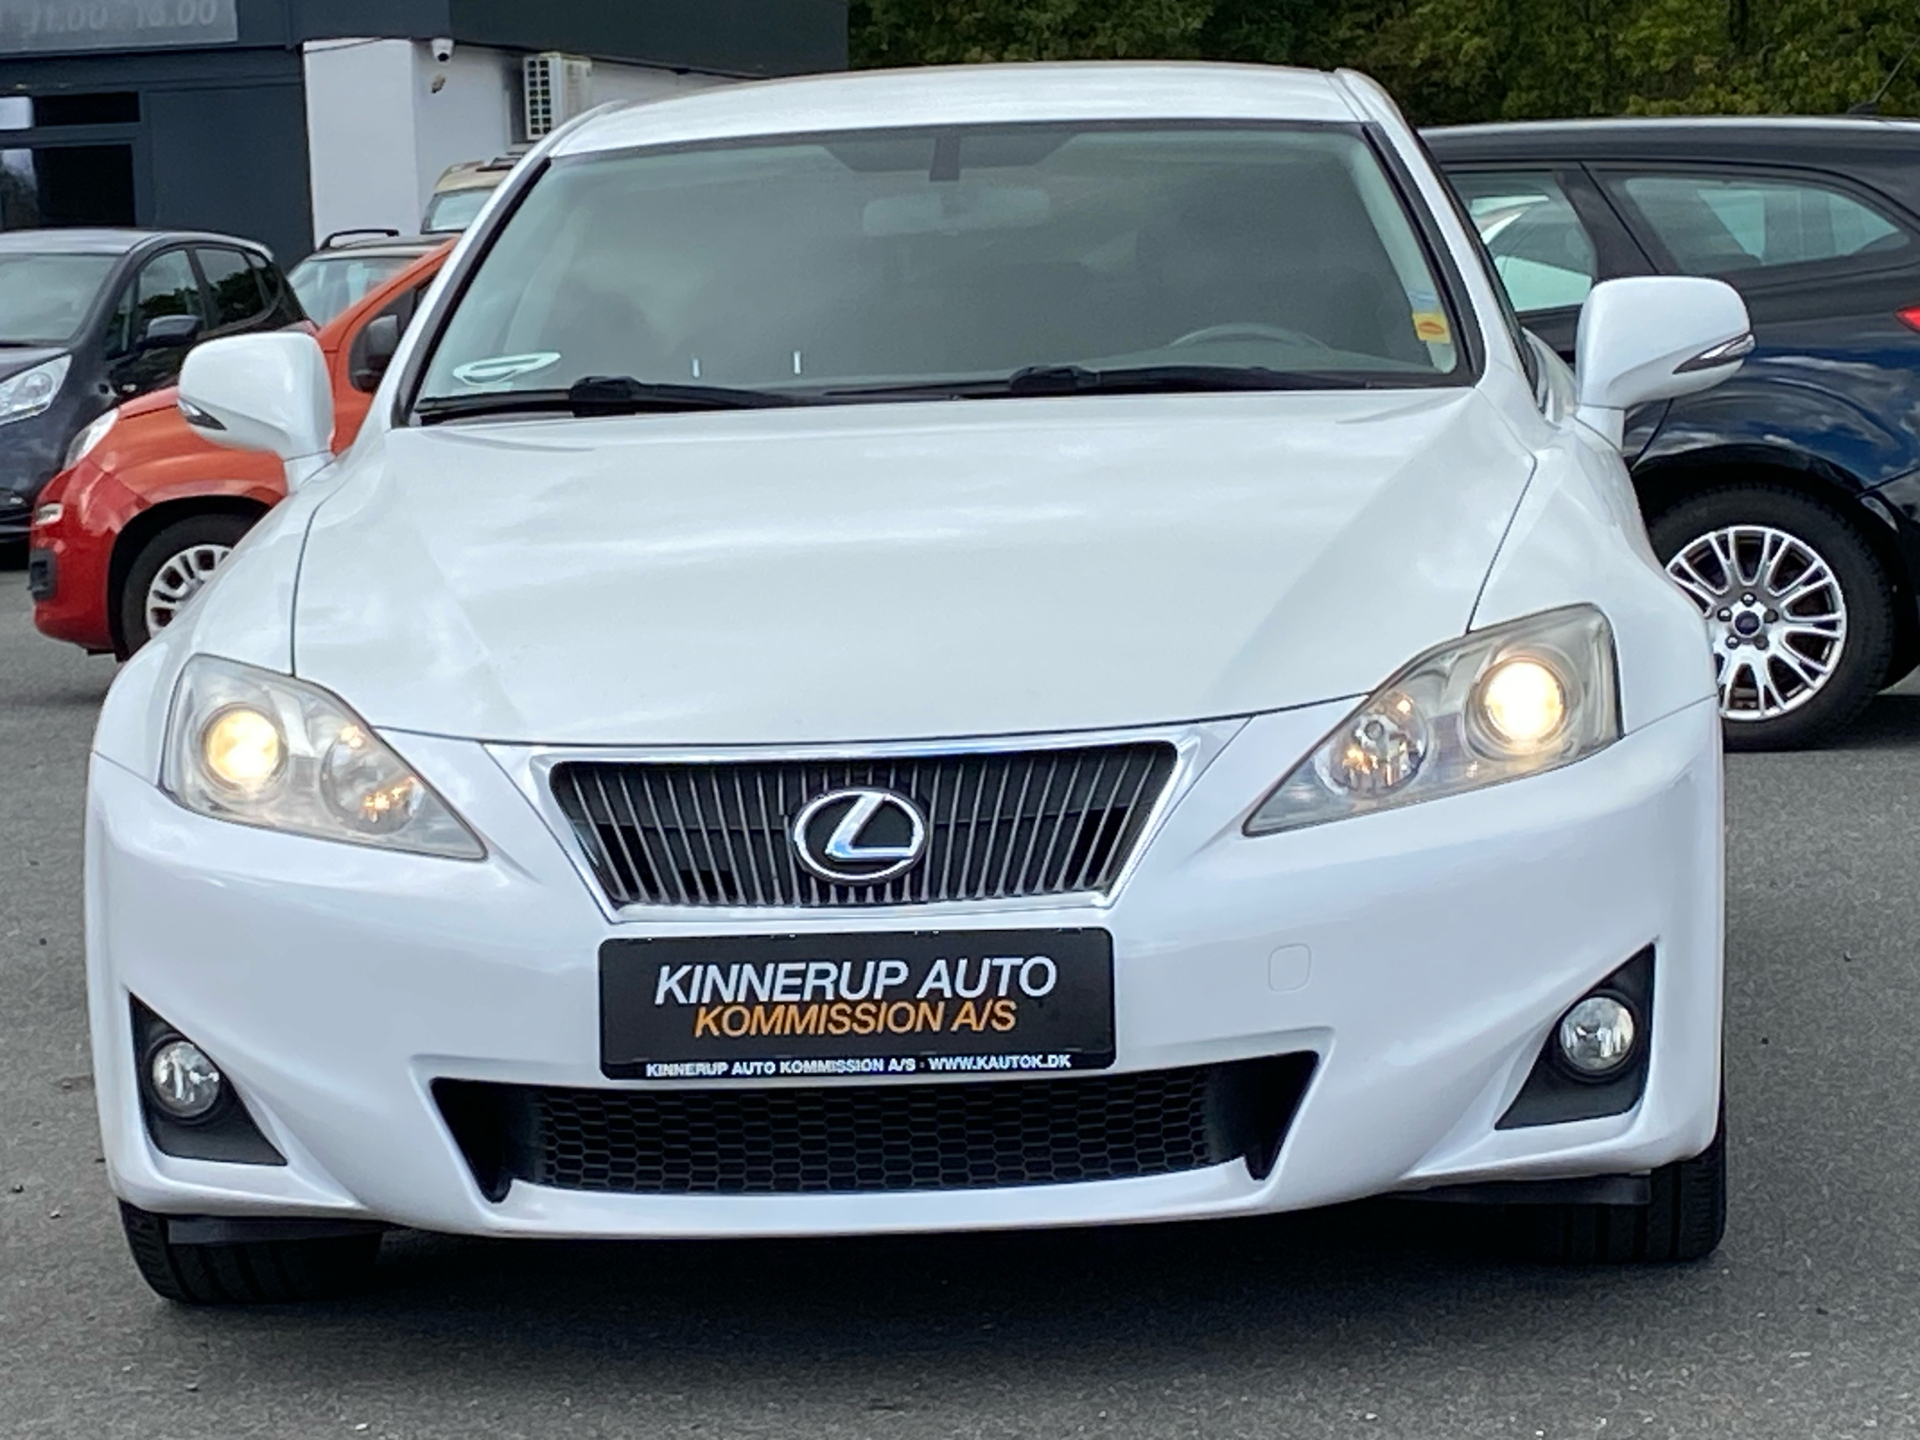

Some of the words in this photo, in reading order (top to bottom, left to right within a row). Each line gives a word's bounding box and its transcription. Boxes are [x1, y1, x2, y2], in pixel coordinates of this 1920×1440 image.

[654, 960, 909, 1005] KINNERUP
[916, 956, 1057, 999] AUTO
[694, 1001, 945, 1038] KOMMISSION
[950, 999, 1017, 1031] A/S
[646, 1062, 729, 1077] KINNERUP
[731, 1061, 776, 1075] AUTO
[780, 1058, 884, 1074] KOMMISSION
[888, 1058, 916, 1071] A/S
[928, 1054, 1071, 1070] WWW.KAUTOK.DK
